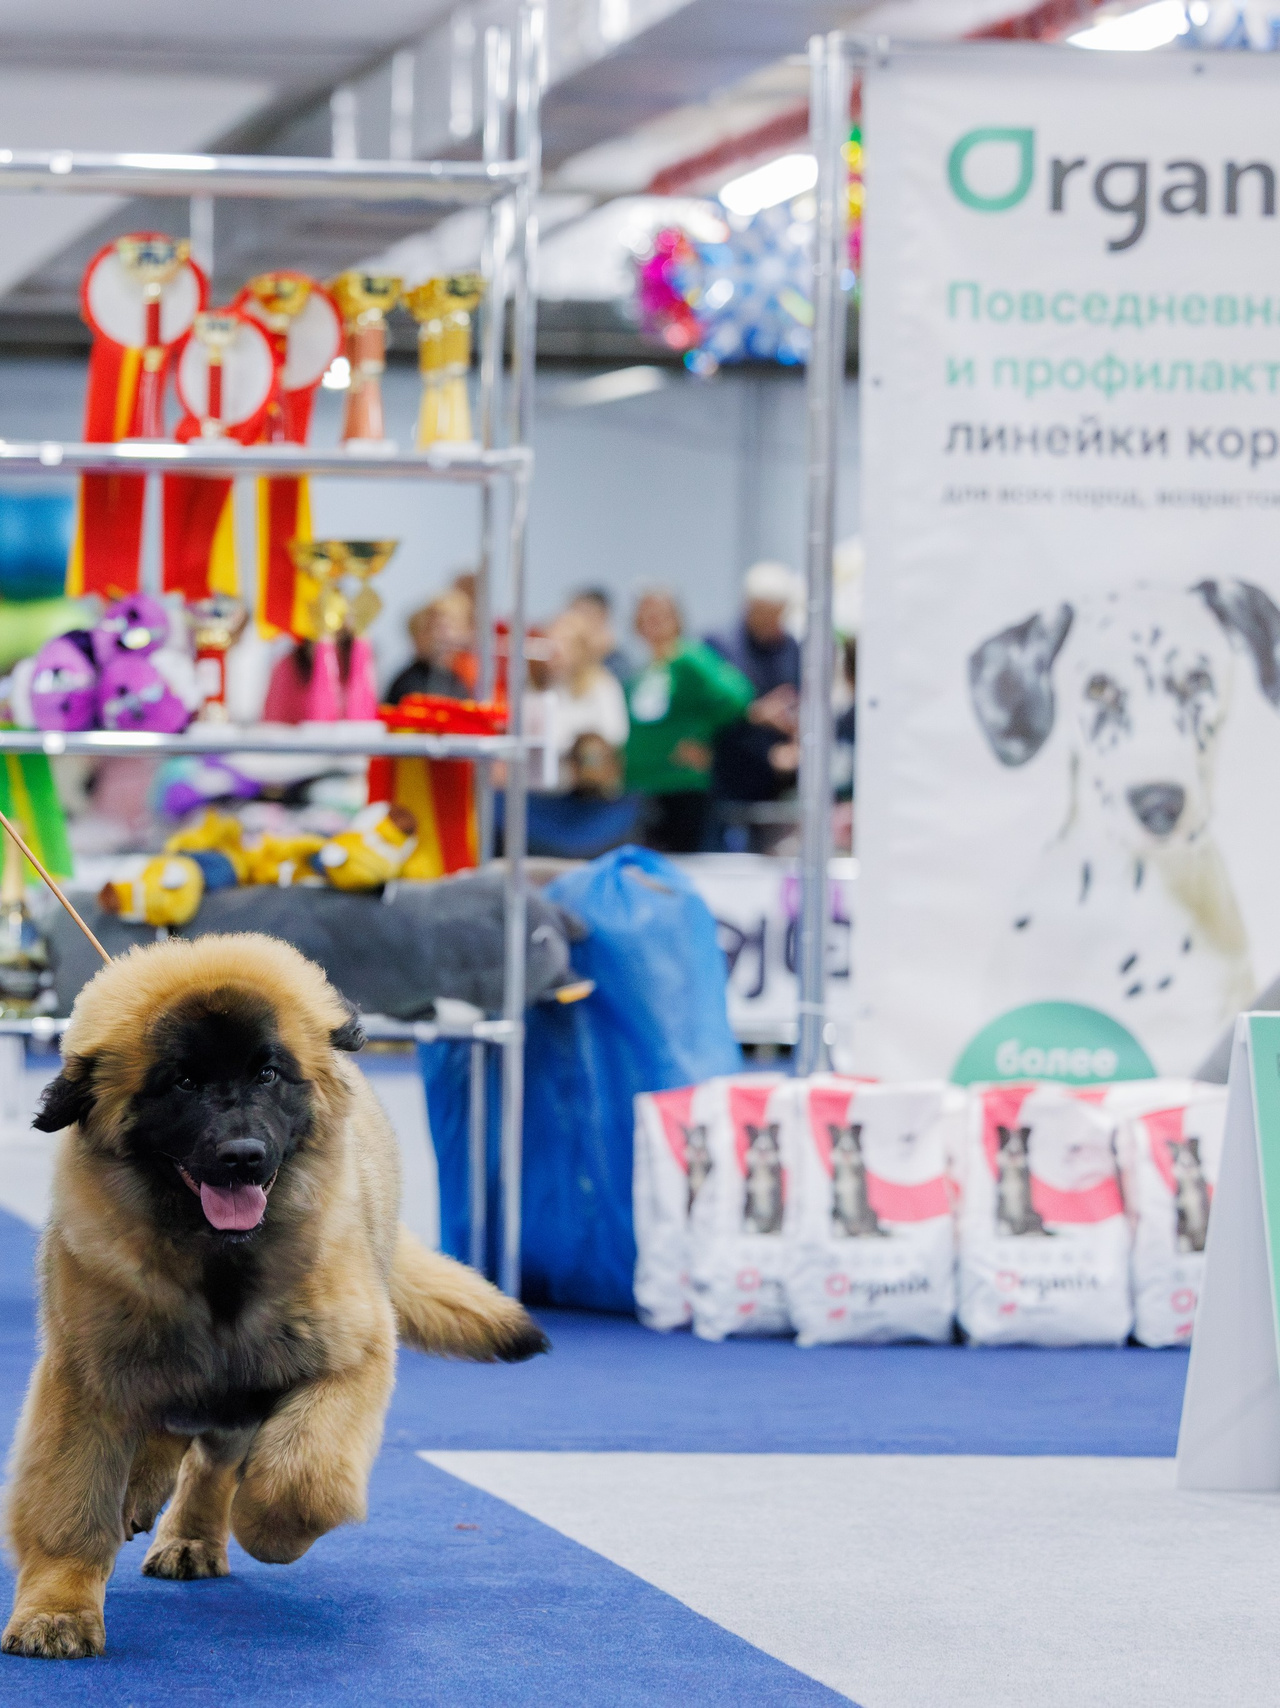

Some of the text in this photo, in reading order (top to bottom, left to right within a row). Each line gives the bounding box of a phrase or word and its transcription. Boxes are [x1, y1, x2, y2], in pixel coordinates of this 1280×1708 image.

[948, 126, 1276, 253] Organ
[947, 281, 1280, 330] Повседневн
[946, 354, 975, 388] и
[944, 413, 1280, 471] линейки кор
[995, 1038, 1118, 1078] более
